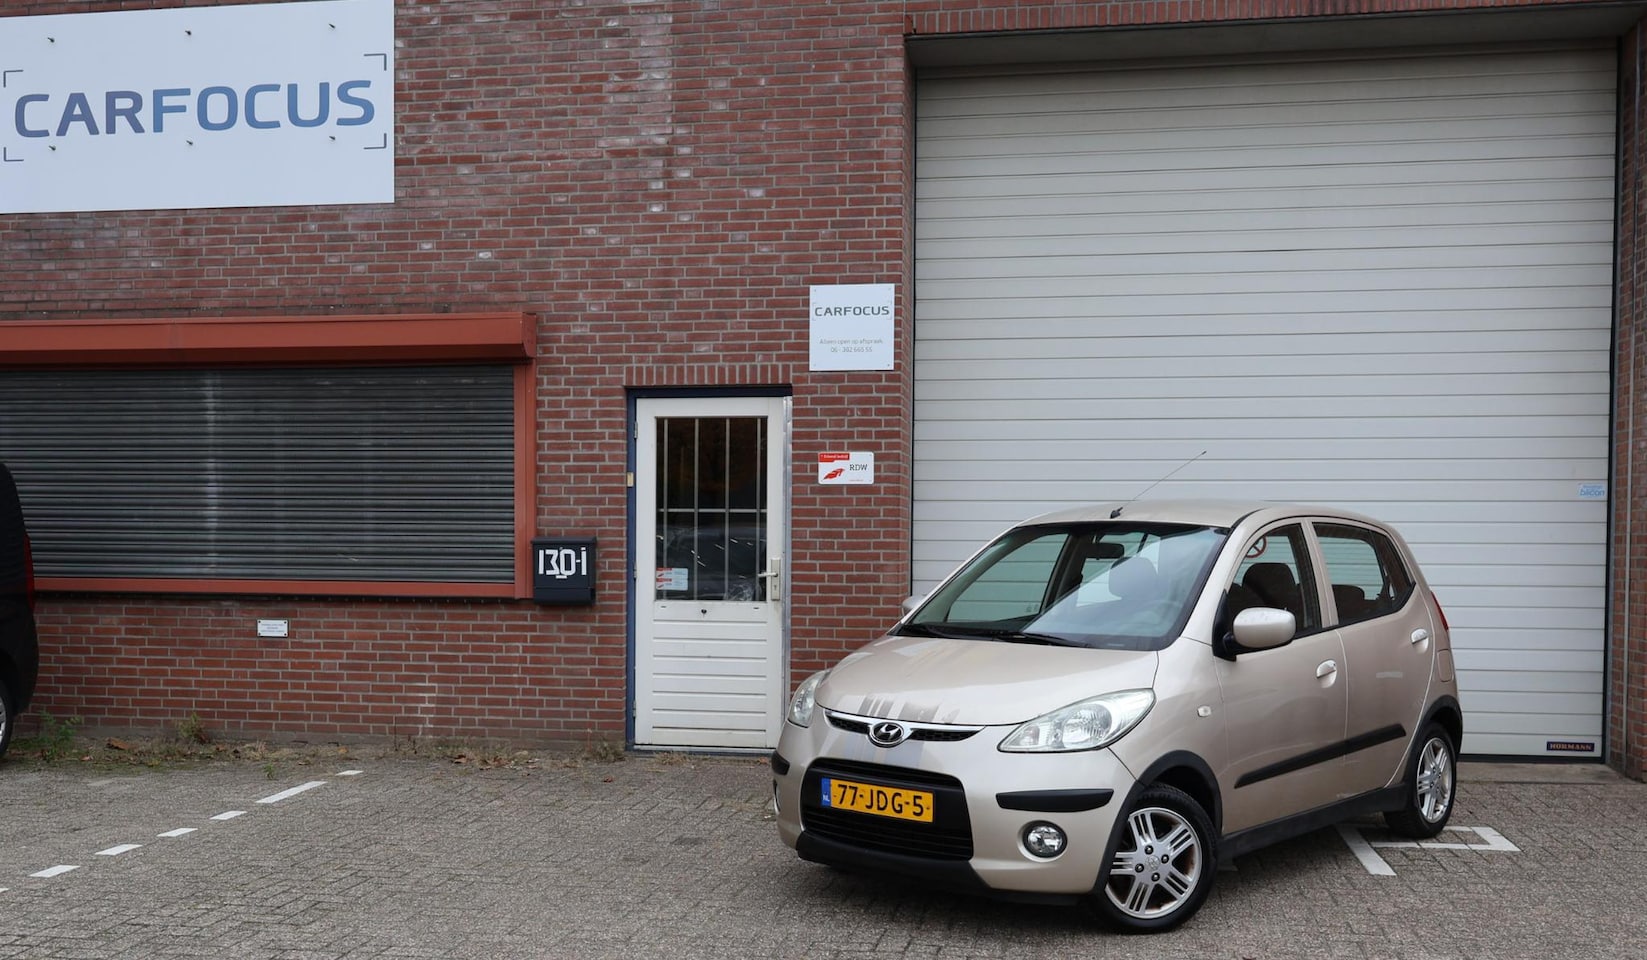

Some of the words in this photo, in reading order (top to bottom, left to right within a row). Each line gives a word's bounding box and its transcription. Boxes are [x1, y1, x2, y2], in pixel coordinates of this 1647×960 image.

[15, 80, 375, 138] CARFOCUS
[815, 306, 890, 317] CARFOCUS
[838, 784, 924, 817] 77-JDG-5
